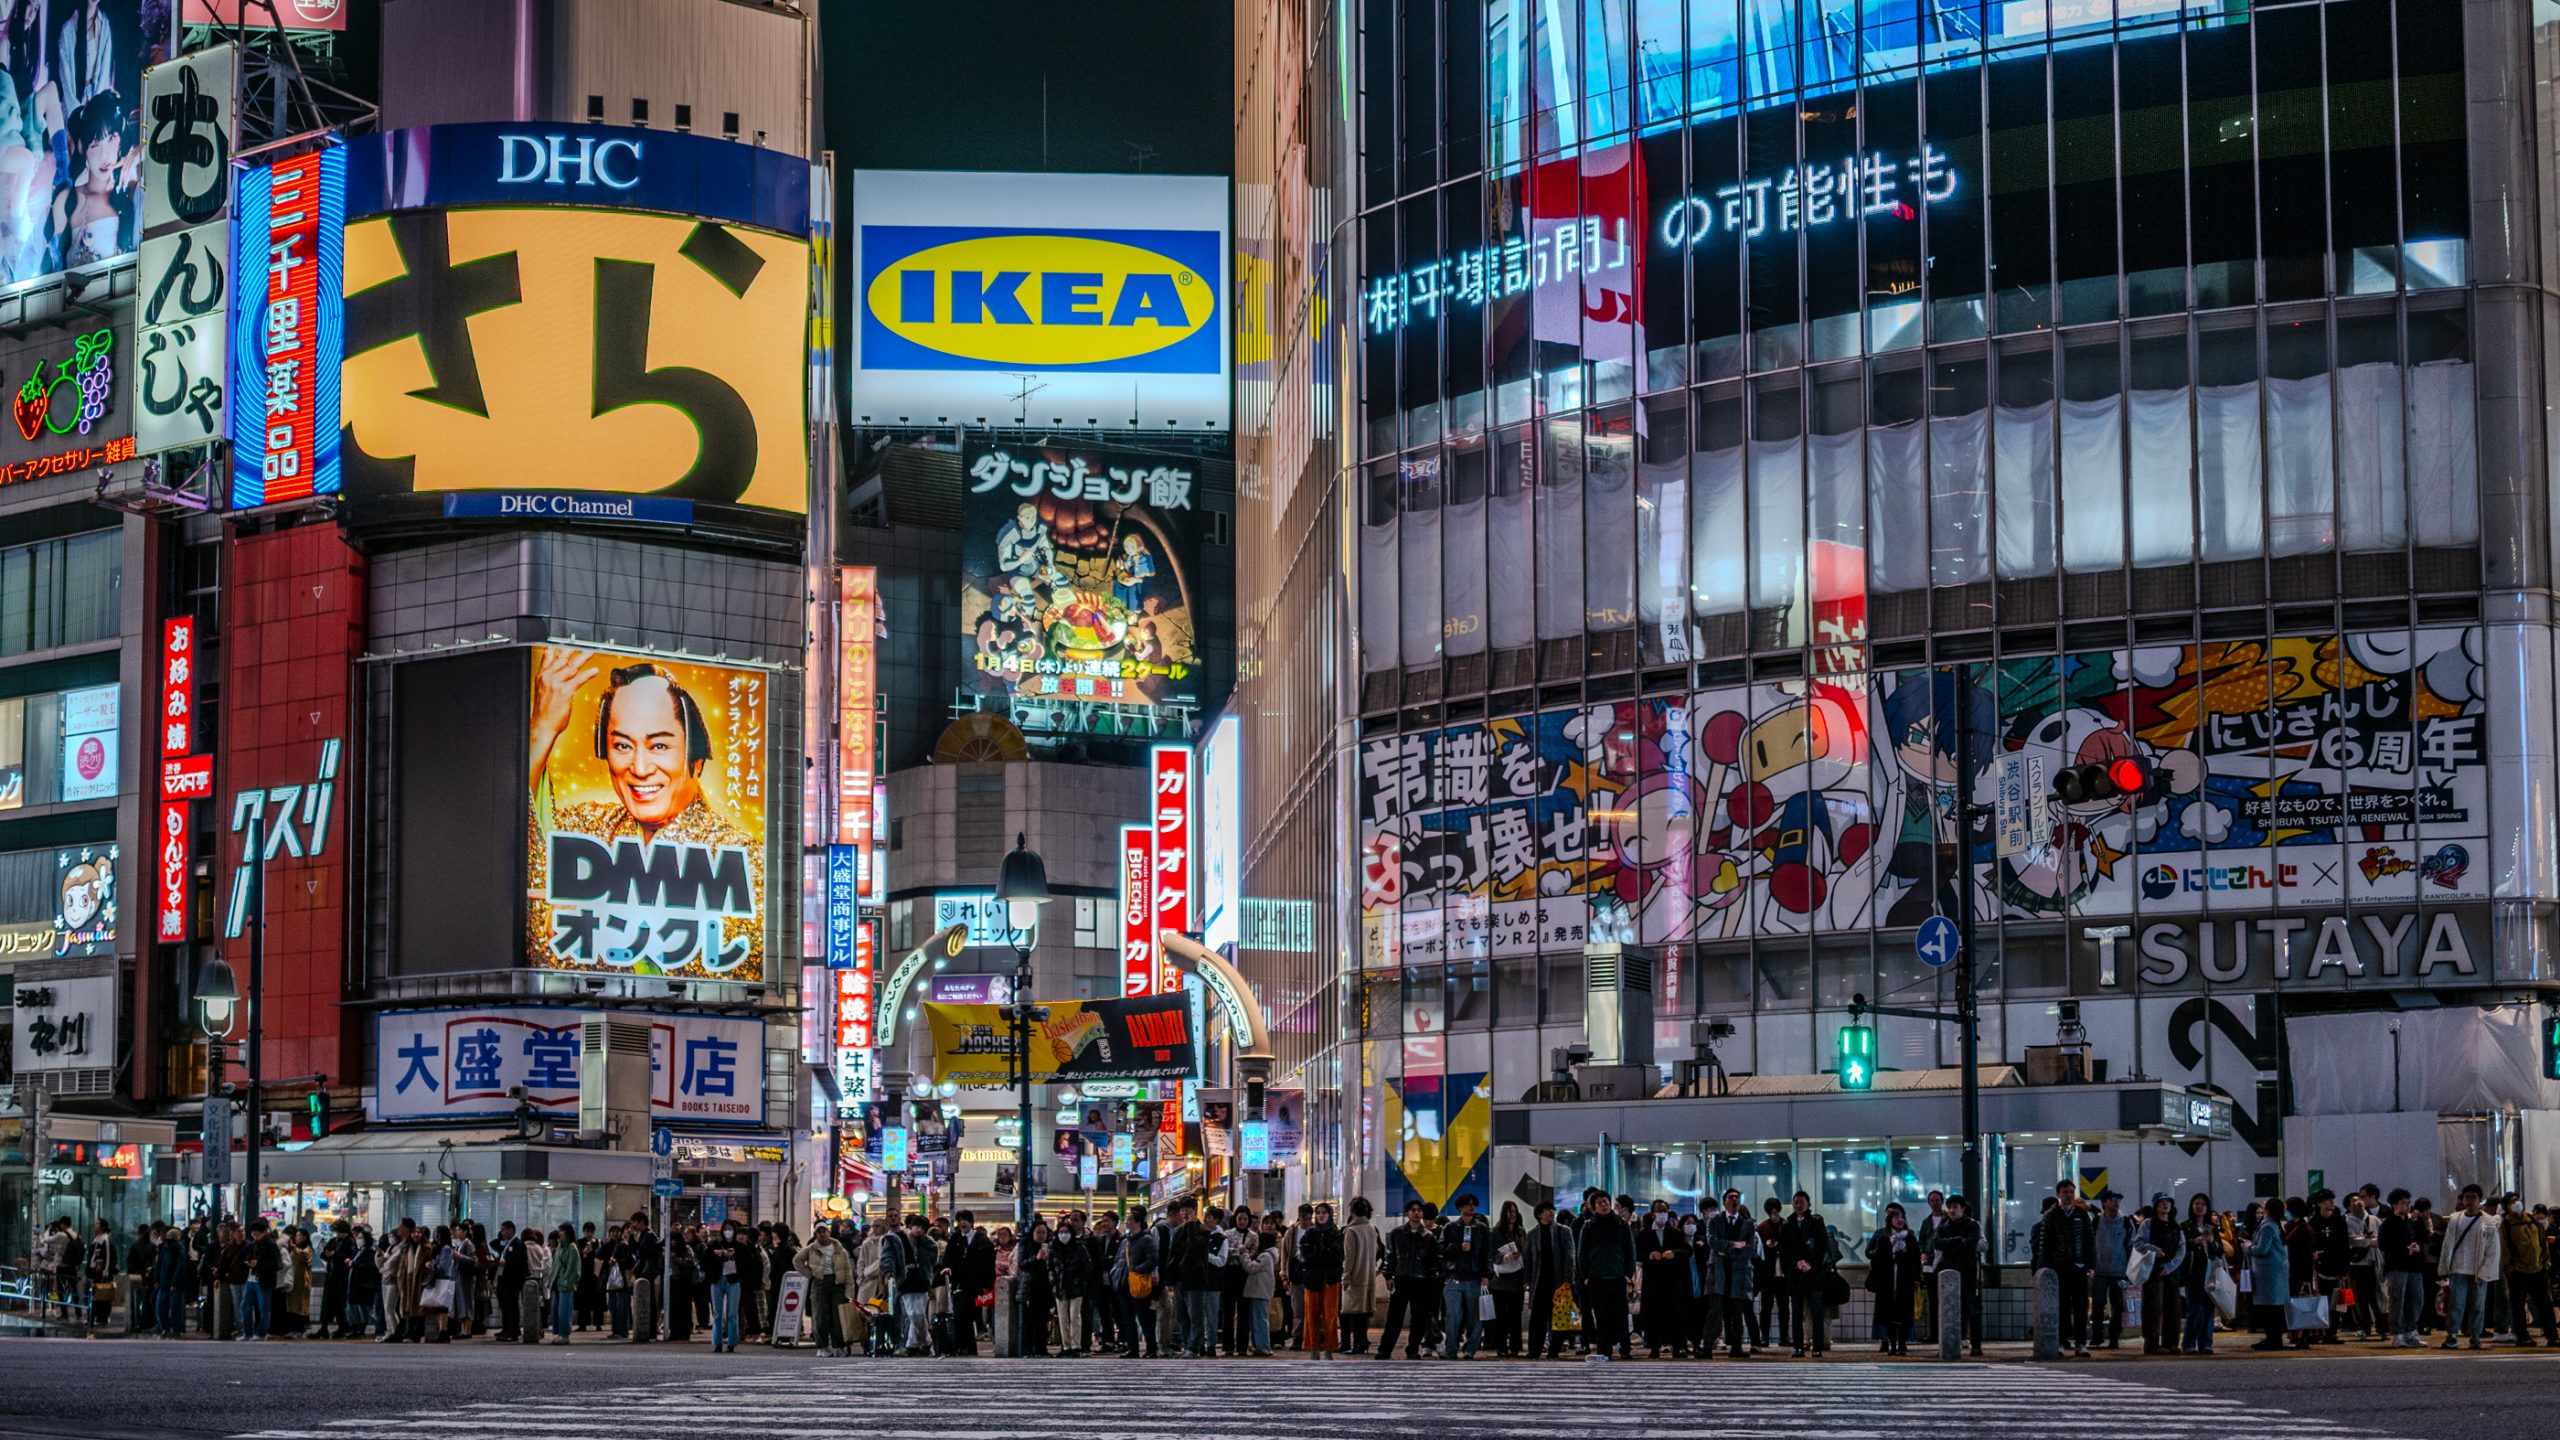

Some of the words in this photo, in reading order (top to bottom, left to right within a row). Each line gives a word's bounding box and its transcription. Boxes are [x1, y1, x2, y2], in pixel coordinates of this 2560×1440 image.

[497, 135, 642, 189] DHC
[141, 64, 228, 433] もんじゃ
[263, 168, 306, 481] 三千里薬品
[900, 269, 1191, 328] IKEA
[105, 436, 135, 464] 雑貨
[970, 451, 1192, 511] ダンジョン飯
[500, 495, 547, 514] DHC
[551, 496, 633, 516] Channel
[166, 625, 189, 750] お好み焼
[847, 576, 869, 755] クスリのことなら
[974, 652, 1188, 681] 1月4日(木)より連続2クール
[1040, 675, 1124, 698] 放送開始!!
[746, 678, 760, 798] クレーンゲームは
[2210, 678, 2400, 750] にじさんじ
[2320, 717, 2478, 773] 6周年
[726, 676, 743, 819] オンラインの時代へ。
[1362, 731, 1546, 826] 常識を
[1998, 776, 2007, 816] Shibuya
[2007, 760, 2023, 847] 渋谷駅前
[2031, 760, 2045, 841] スクランブル式
[2245, 793, 2448, 816] 好きなもので、世界をつくれ。
[2258, 818, 2305, 828] SHIBUYA
[2309, 815, 2357, 827] TSUTAYA
[2361, 812, 2409, 823] RENEWAL
[2436, 812, 2462, 821] SPRING
[162, 807, 184, 936] もんじゃ焼
[1127, 848, 1143, 880] BIG
[1157, 768, 1185, 912] カラオケ
[549, 834, 755, 915] DMM
[1127, 884, 1143, 926] ECHO
[2183, 863, 2299, 893] にじさんじ
[550, 908, 750, 969] オンクレ
[832, 852, 852, 963] 大盛堂商事ビル
[56, 928, 117, 956] Jasmine
[2083, 912, 2476, 987] TSUTAYA
[880, 953, 920, 1042] 渋谷センター街
[396, 1028, 738, 1098] 大盛堂店
[843, 1051, 866, 1099] 牛繁
[207, 1104, 219, 1169] 文化村通り
[681, 1101, 709, 1113] BOOKS
[713, 1103, 750, 1115] TAISEIDO
